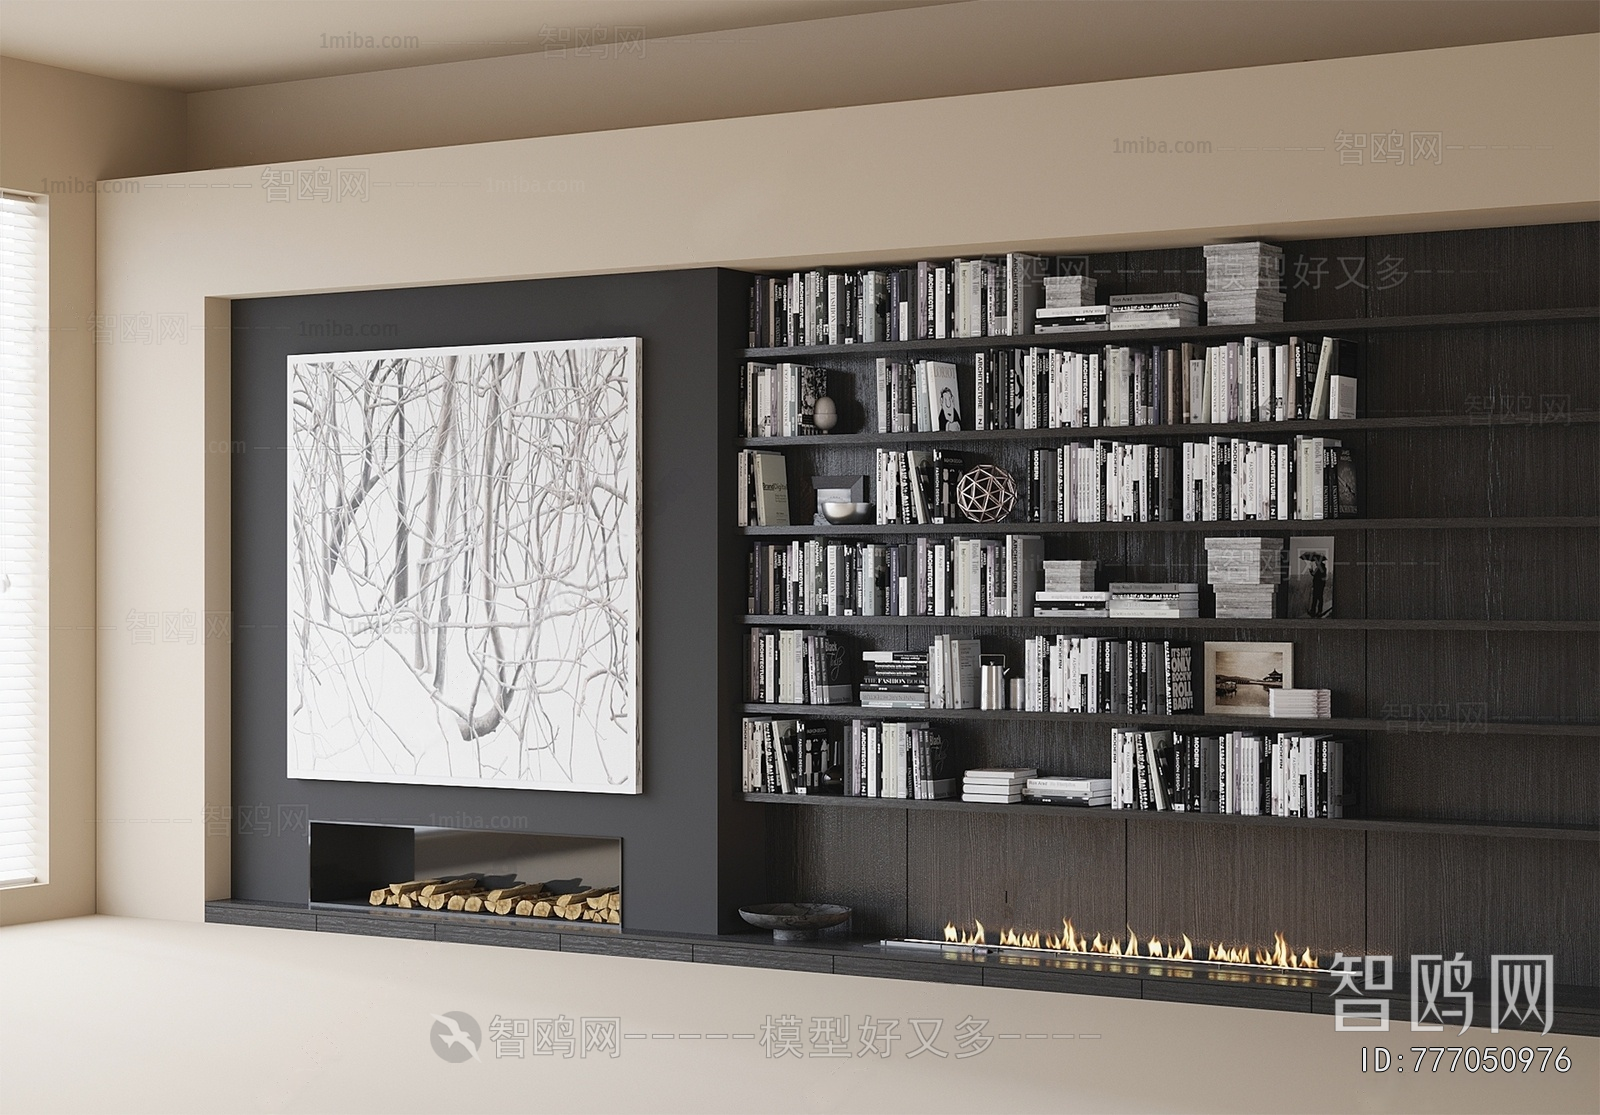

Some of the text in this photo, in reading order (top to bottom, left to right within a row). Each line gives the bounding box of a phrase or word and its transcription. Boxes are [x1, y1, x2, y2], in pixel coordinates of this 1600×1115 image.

[1171, 657, 1191, 672] ONLY
[1172, 681, 1193, 697] ROLL
[1173, 697, 1193, 710] BABY!
